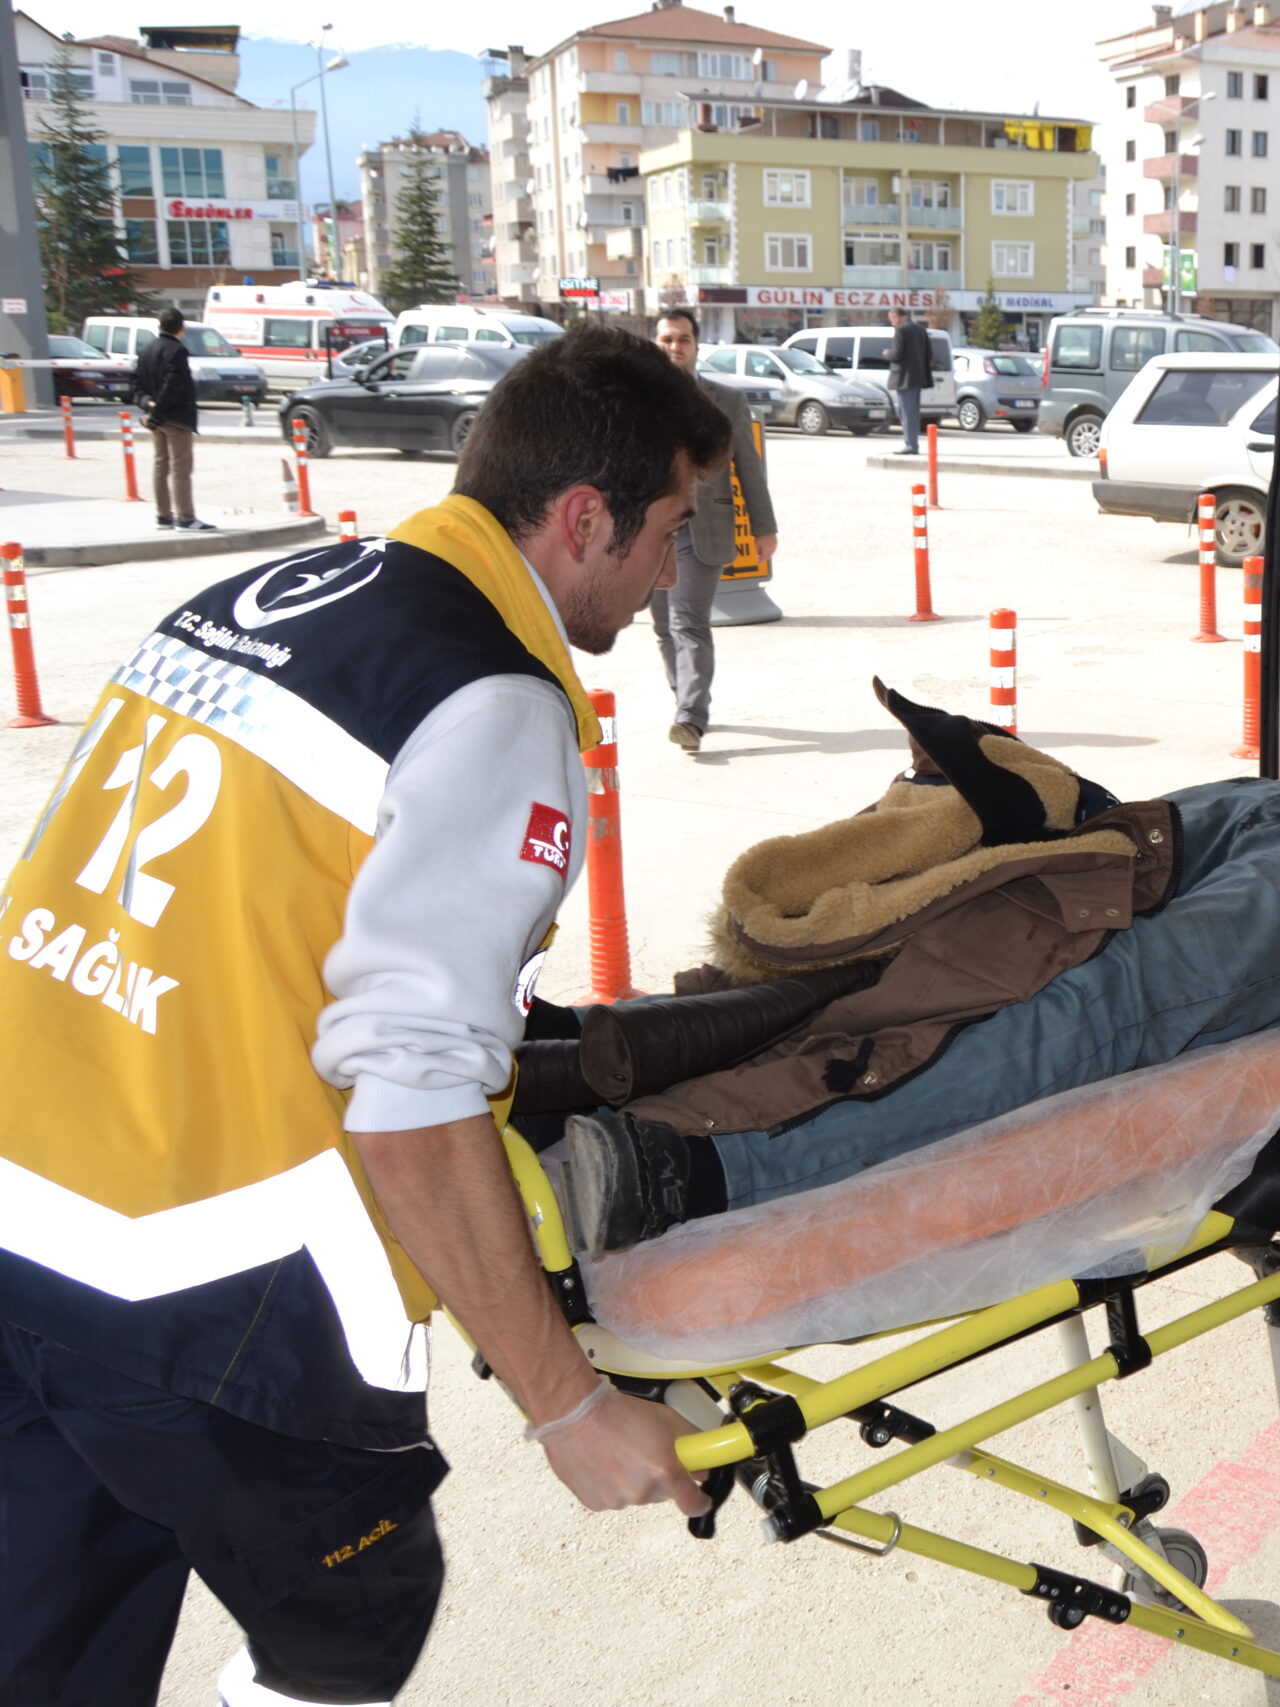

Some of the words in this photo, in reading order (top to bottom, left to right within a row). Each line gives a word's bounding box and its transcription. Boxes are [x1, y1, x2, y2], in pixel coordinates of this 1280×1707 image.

[194, 621, 239, 650] Sağlık
[9, 908, 180, 1035] SAĞLIK
[322, 1545, 357, 1568] 112
